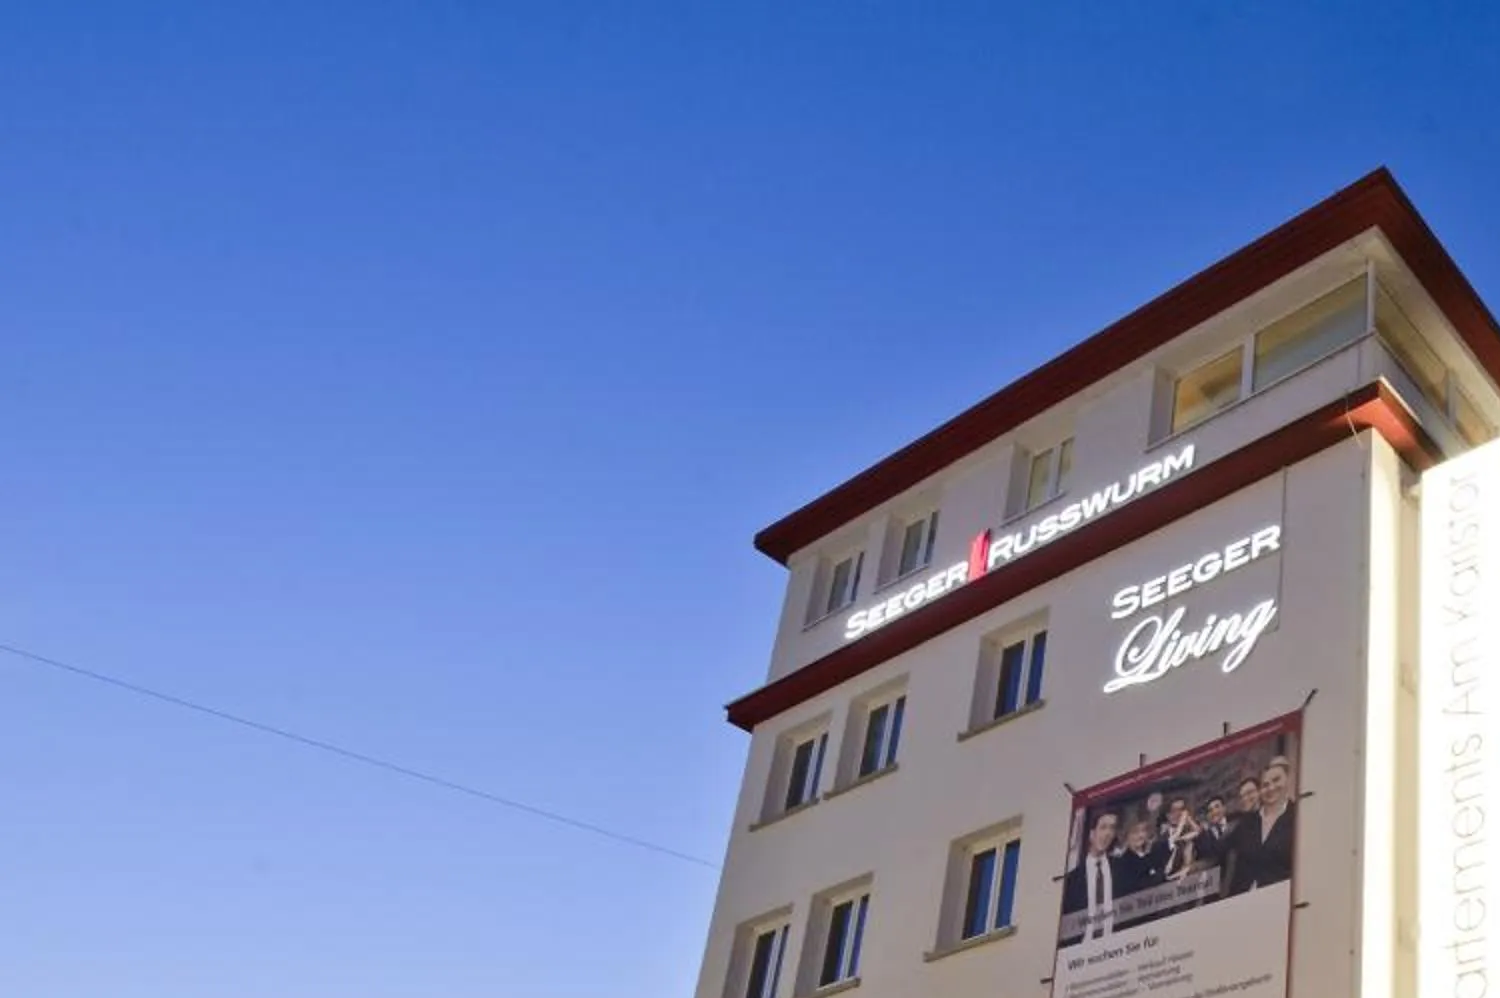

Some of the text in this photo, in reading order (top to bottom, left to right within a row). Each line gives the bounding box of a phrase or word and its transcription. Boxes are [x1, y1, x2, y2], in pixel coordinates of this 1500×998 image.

[844, 444, 1196, 640] SEEGER RUSSWURM
[1111, 525, 1282, 620] SEEGER
[1104, 599, 1277, 693] Living
[1441, 634, 1487, 716] Am
